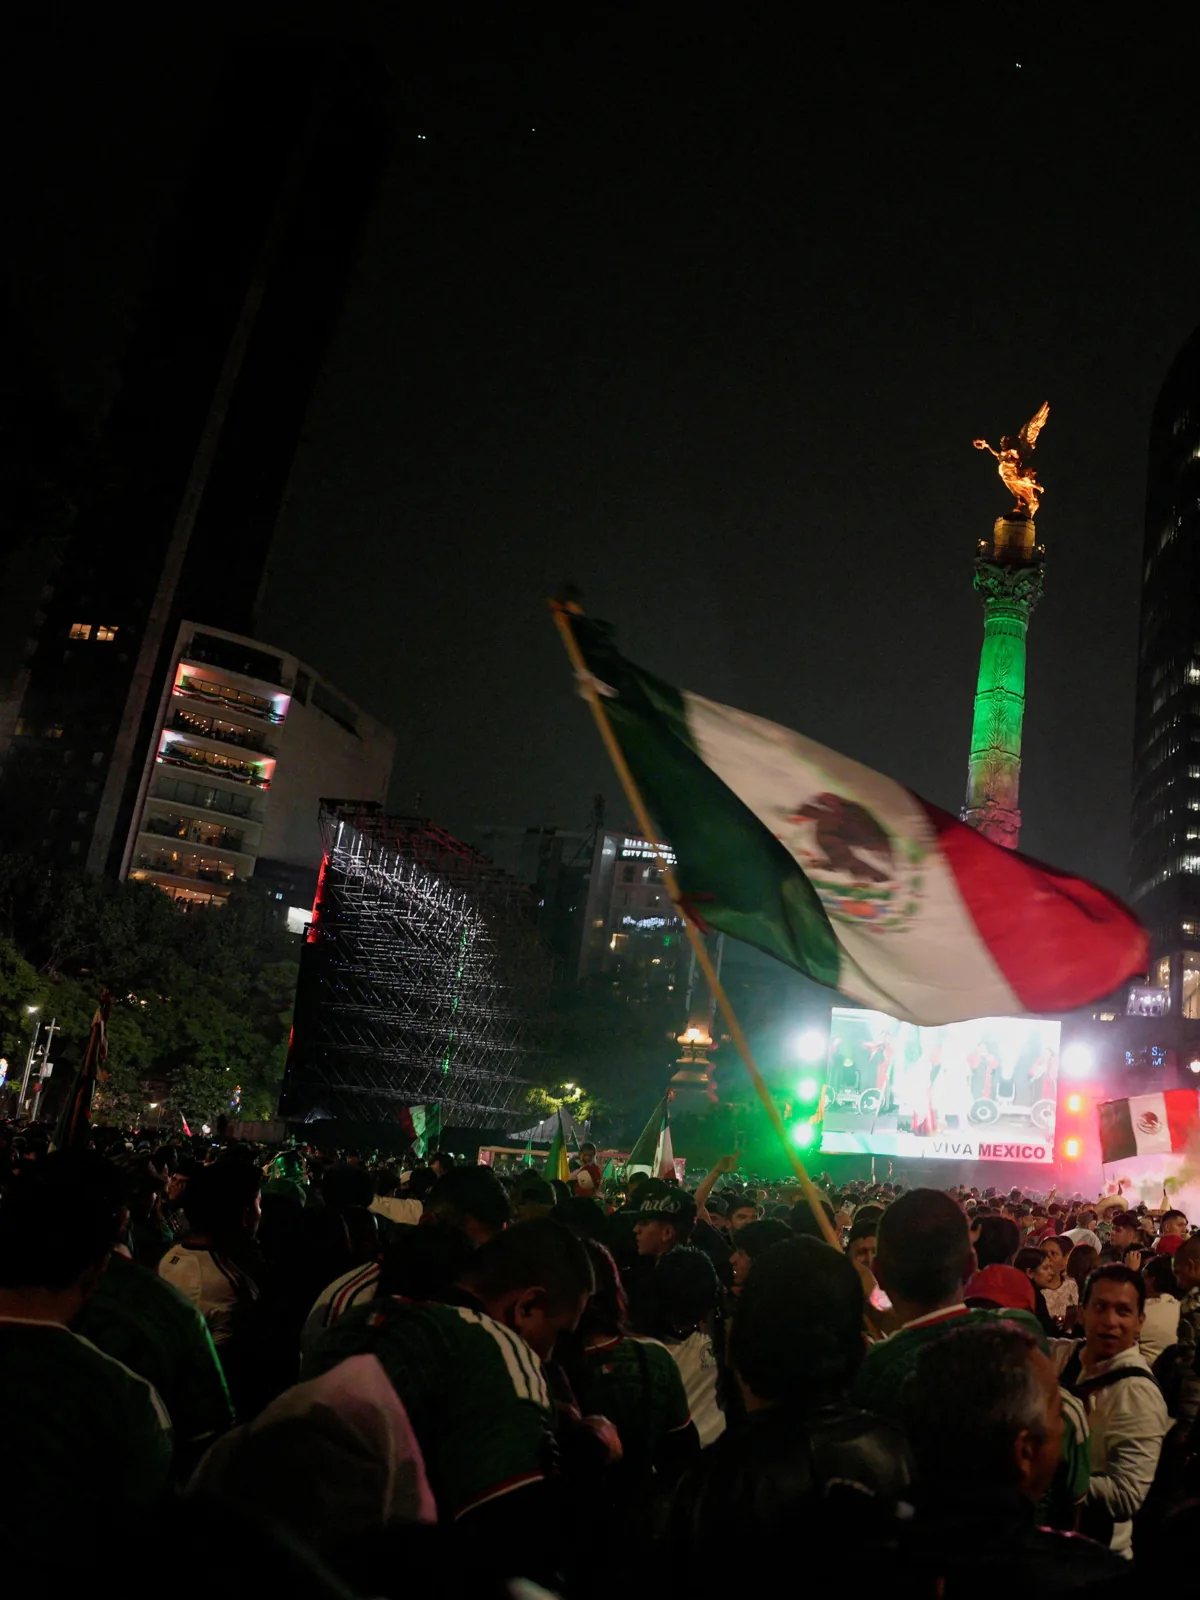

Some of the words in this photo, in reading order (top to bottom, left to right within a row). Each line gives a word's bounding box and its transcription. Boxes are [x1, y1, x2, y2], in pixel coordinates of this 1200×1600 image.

[622, 849, 642, 857] CITY
[933, 1142, 973, 1155] VIVA
[978, 1143, 1046, 1160] MEXICO
